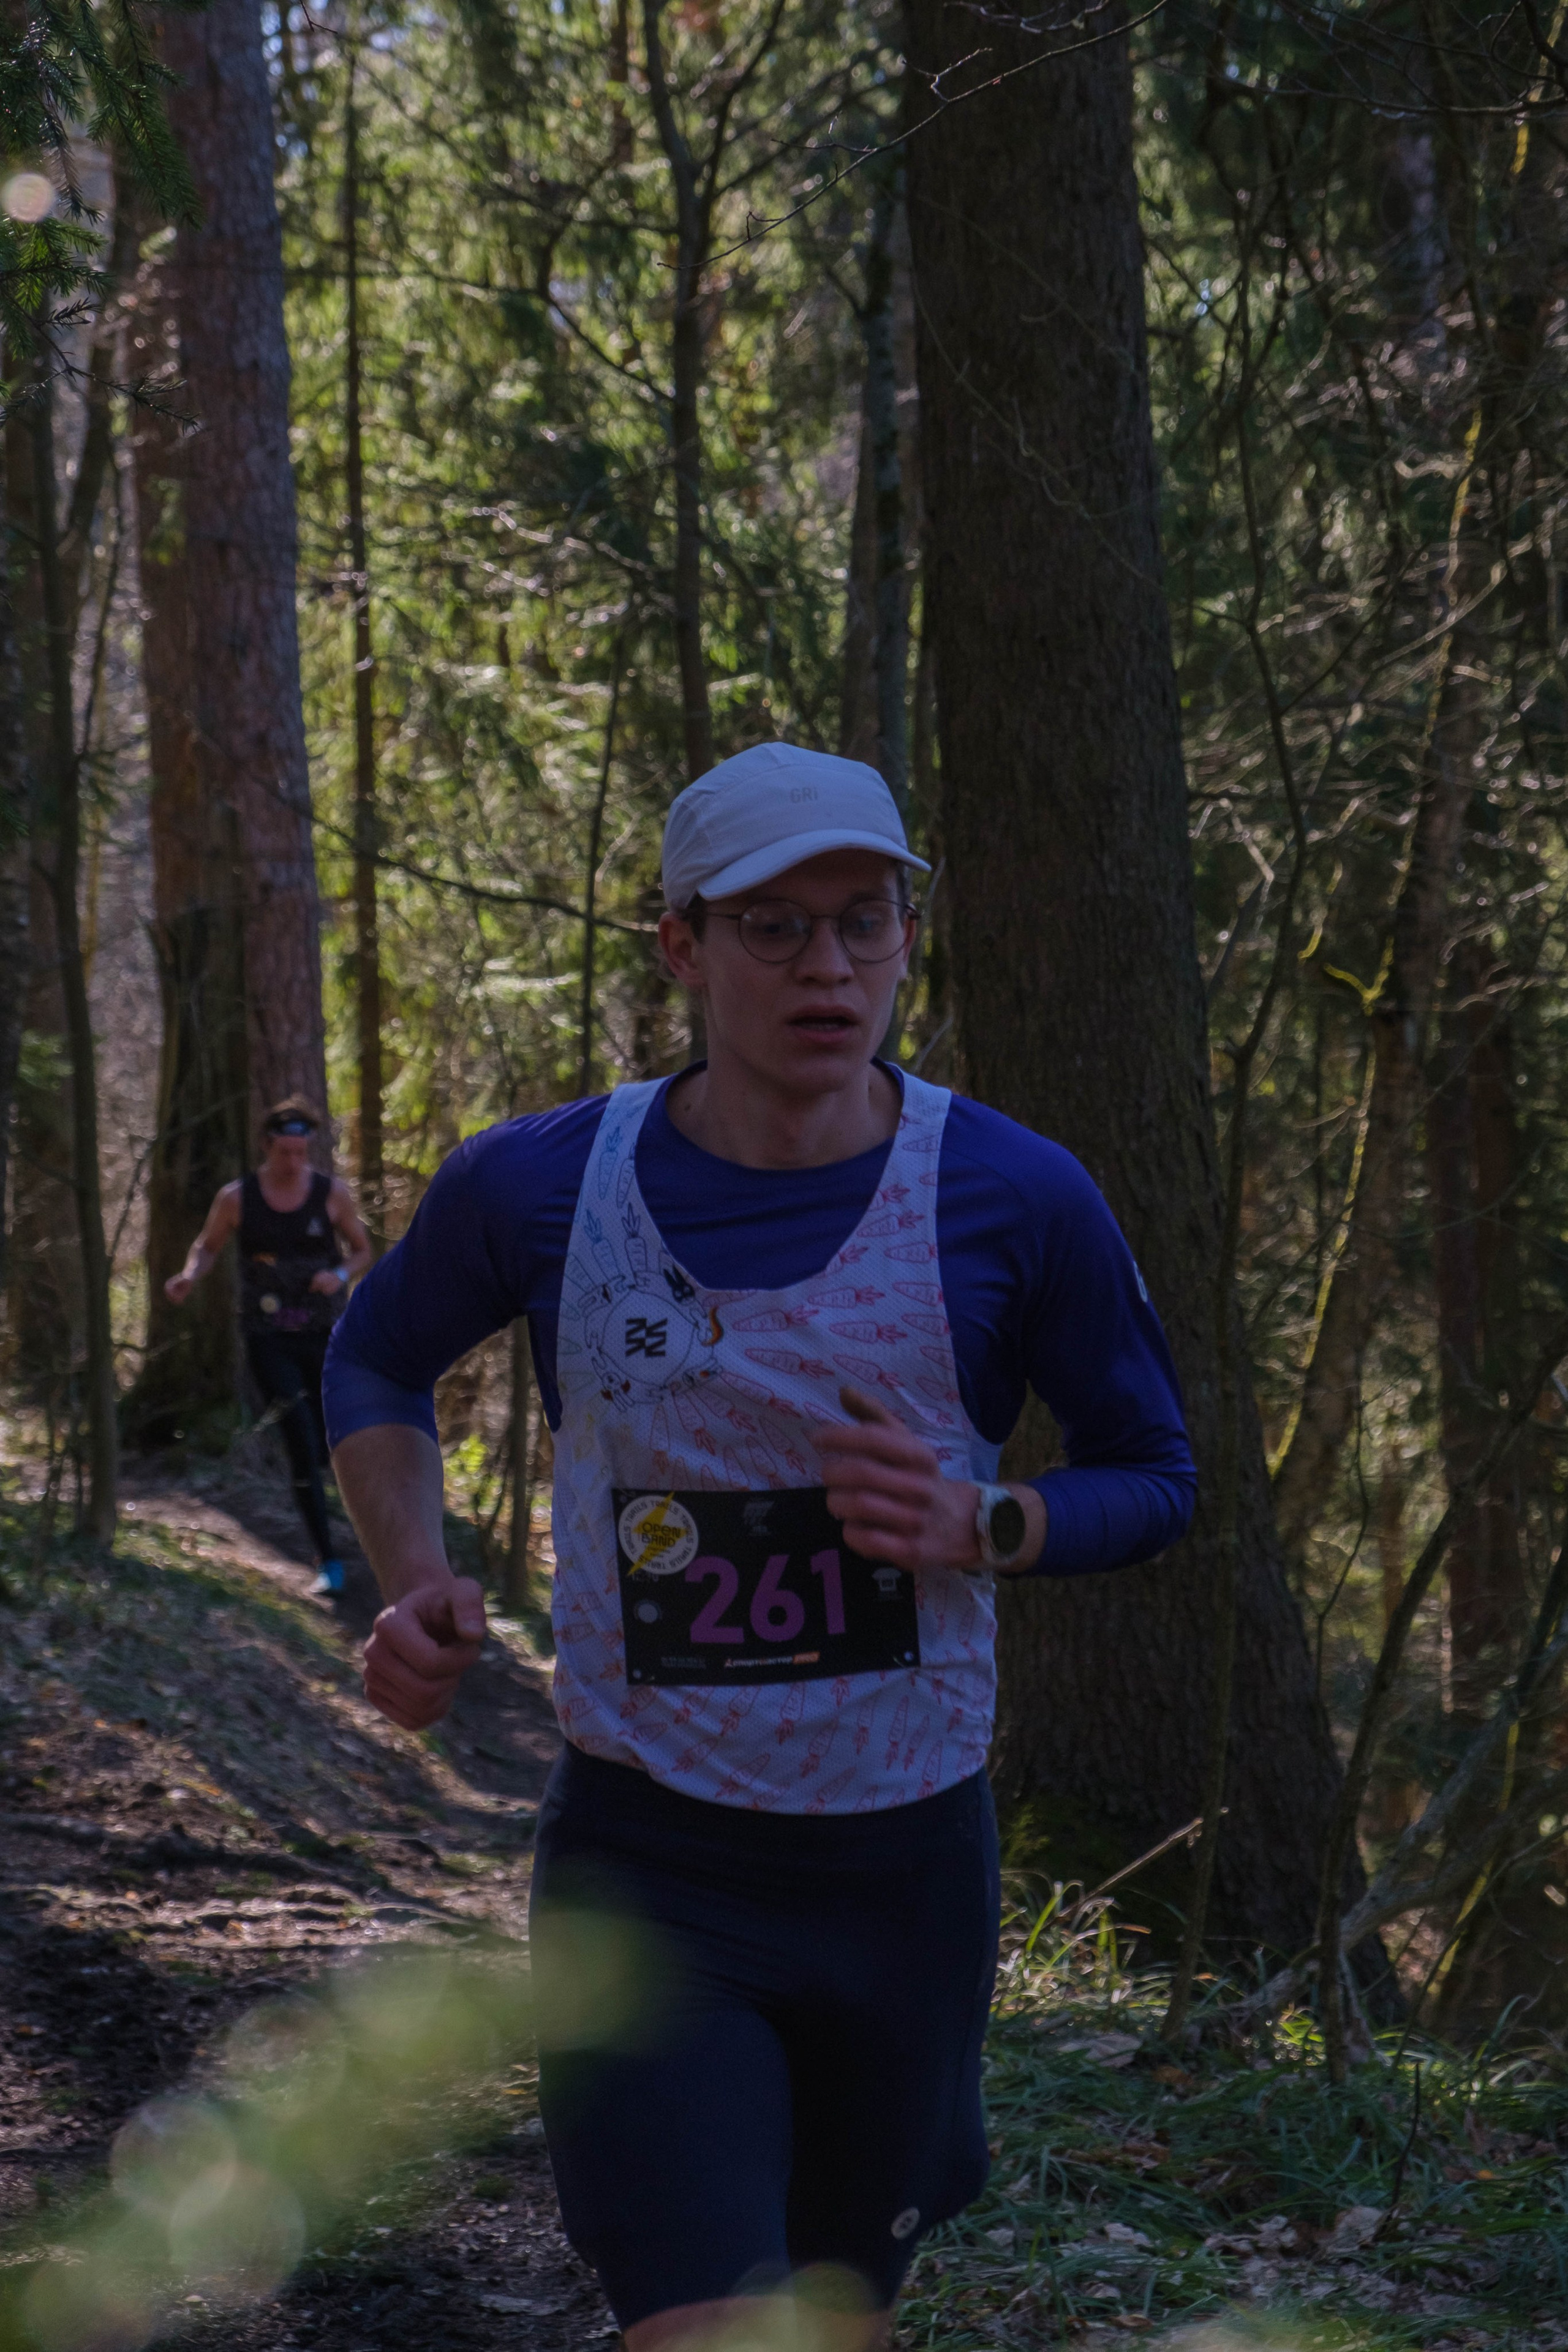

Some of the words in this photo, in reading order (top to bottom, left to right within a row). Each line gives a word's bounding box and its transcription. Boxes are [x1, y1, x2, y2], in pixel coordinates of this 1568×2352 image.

[625, 1502, 647, 1522] TRAILS
[642, 1533, 676, 1547] BAND
[685, 1549, 846, 1644] 261
